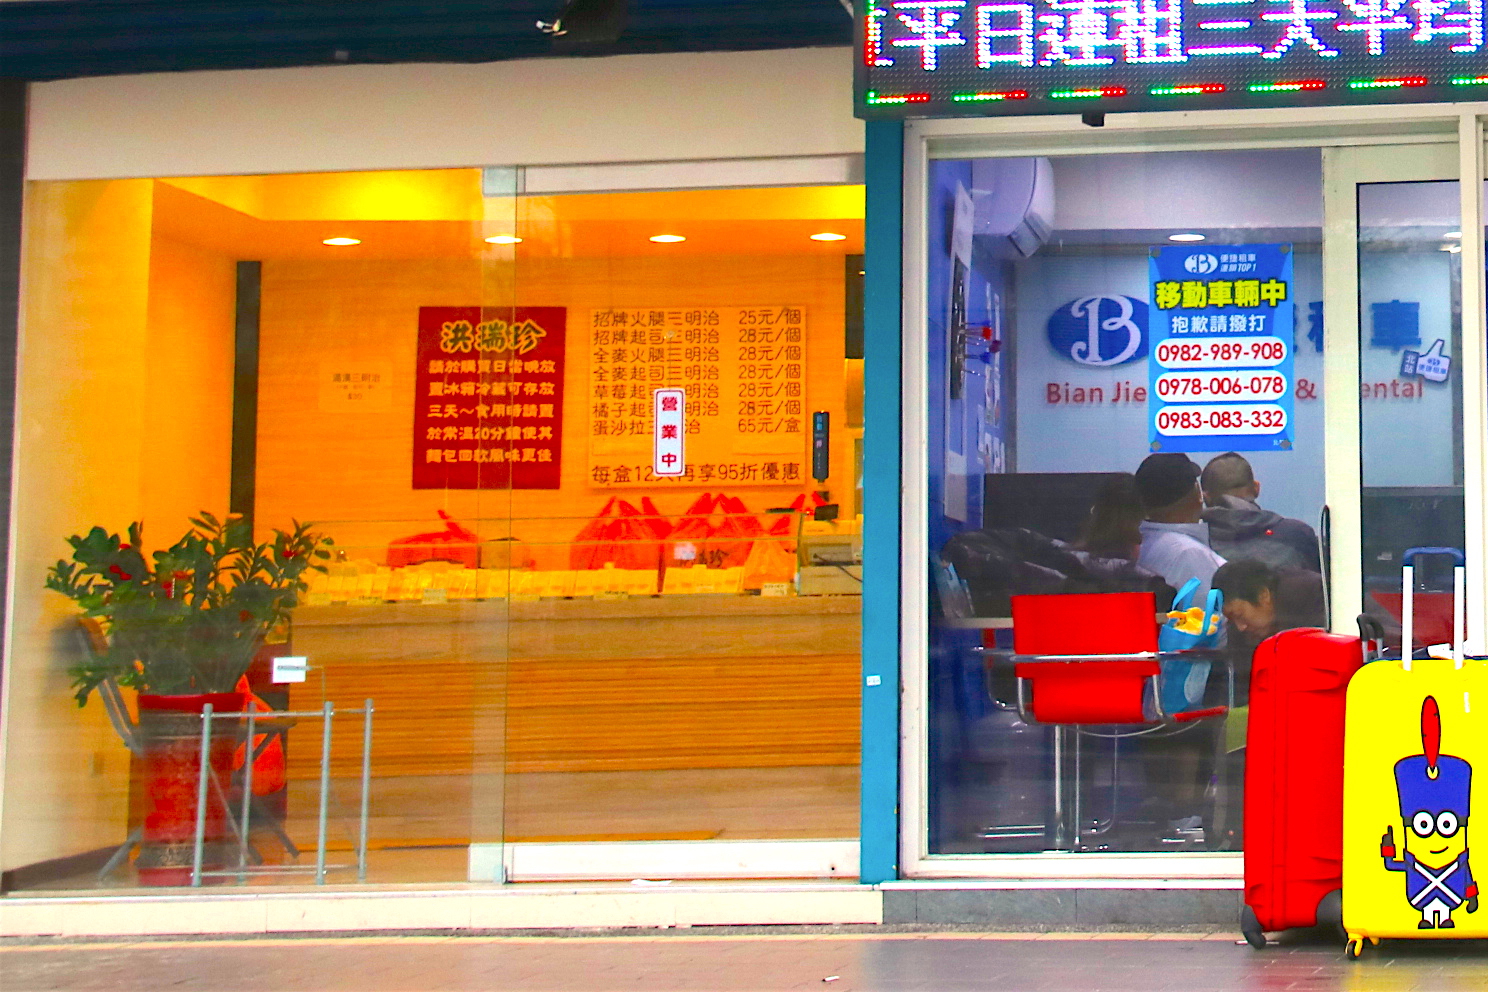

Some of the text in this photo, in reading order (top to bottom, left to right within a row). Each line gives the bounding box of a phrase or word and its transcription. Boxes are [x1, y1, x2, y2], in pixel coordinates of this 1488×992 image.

[1155, 278, 1287, 310] 移動車輛中
[1171, 313, 1267, 334] 抱歉請撥打
[440, 318, 547, 355] 洪瑞珍
[1158, 342, 1284, 363] 0982-989-908
[592, 383, 720, 400] 草莓起明治
[1045, 377, 1425, 405] Bian Jie & ental
[1158, 376, 1284, 396] 0978-006-078
[592, 419, 701, 437] 蛋沙拉治
[1158, 410, 1284, 431] 0983-083-332
[661, 395, 679, 469] 營業中
[591, 461, 800, 484] 每盒12再享95折優惠
